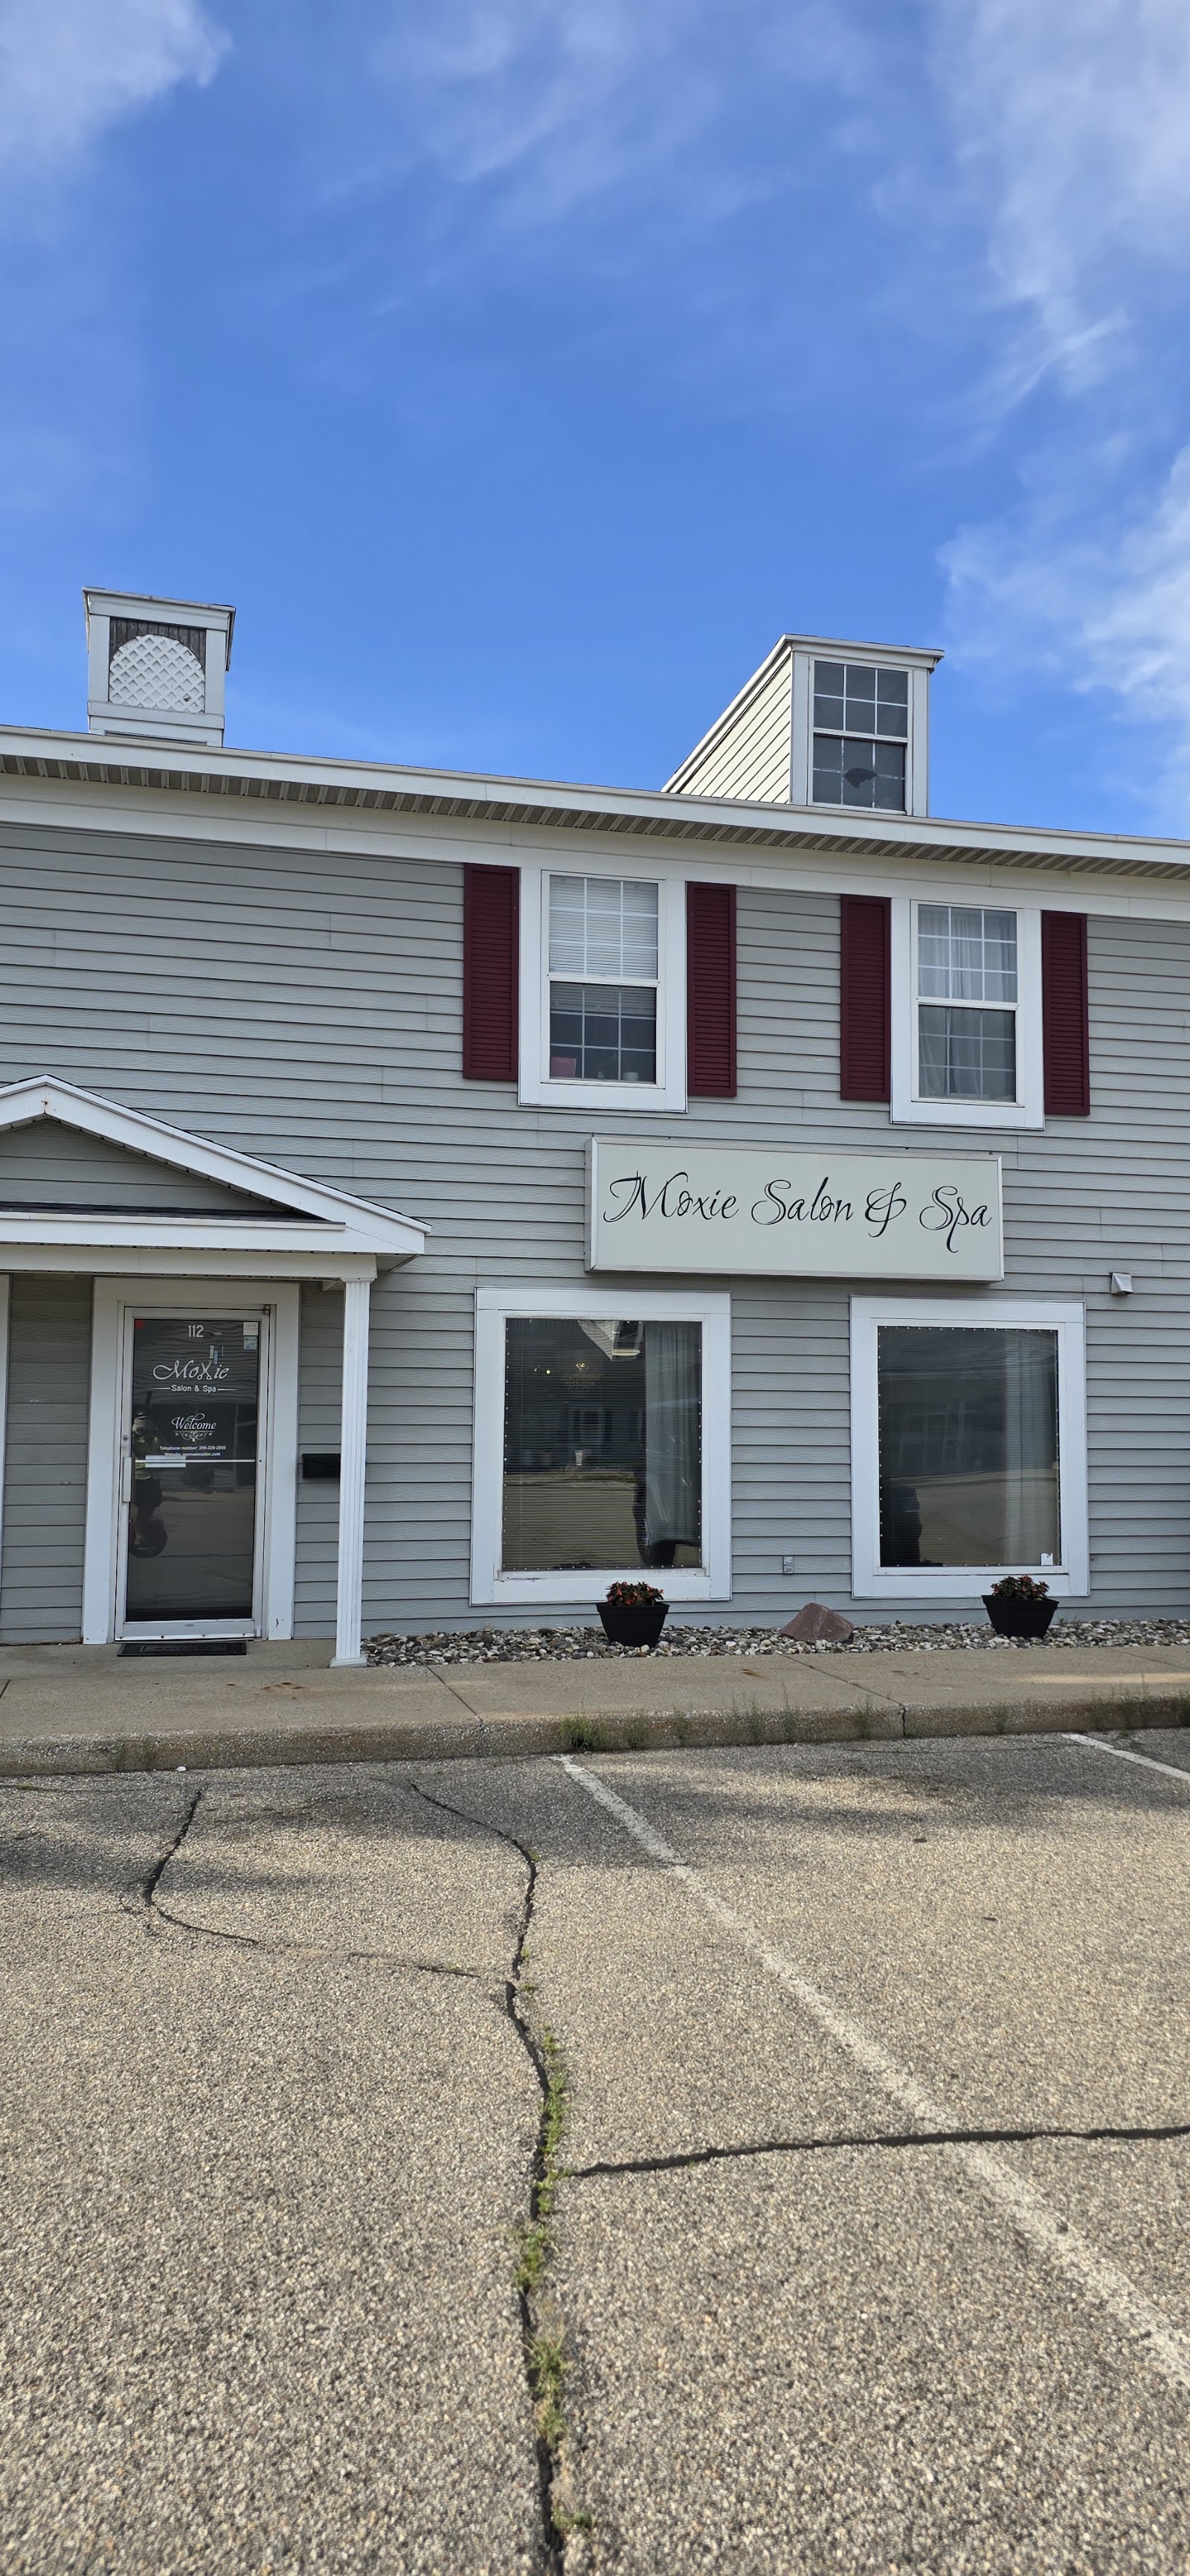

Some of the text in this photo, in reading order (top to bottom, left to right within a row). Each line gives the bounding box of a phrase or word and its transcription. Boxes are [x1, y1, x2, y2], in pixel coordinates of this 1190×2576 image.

[603, 1171, 992, 1253] Moxie Salon & Spa
[188, 1325, 204, 1337] 112
[202, 1385, 216, 1393] Spa
[171, 1413, 217, 1430] Welcome
